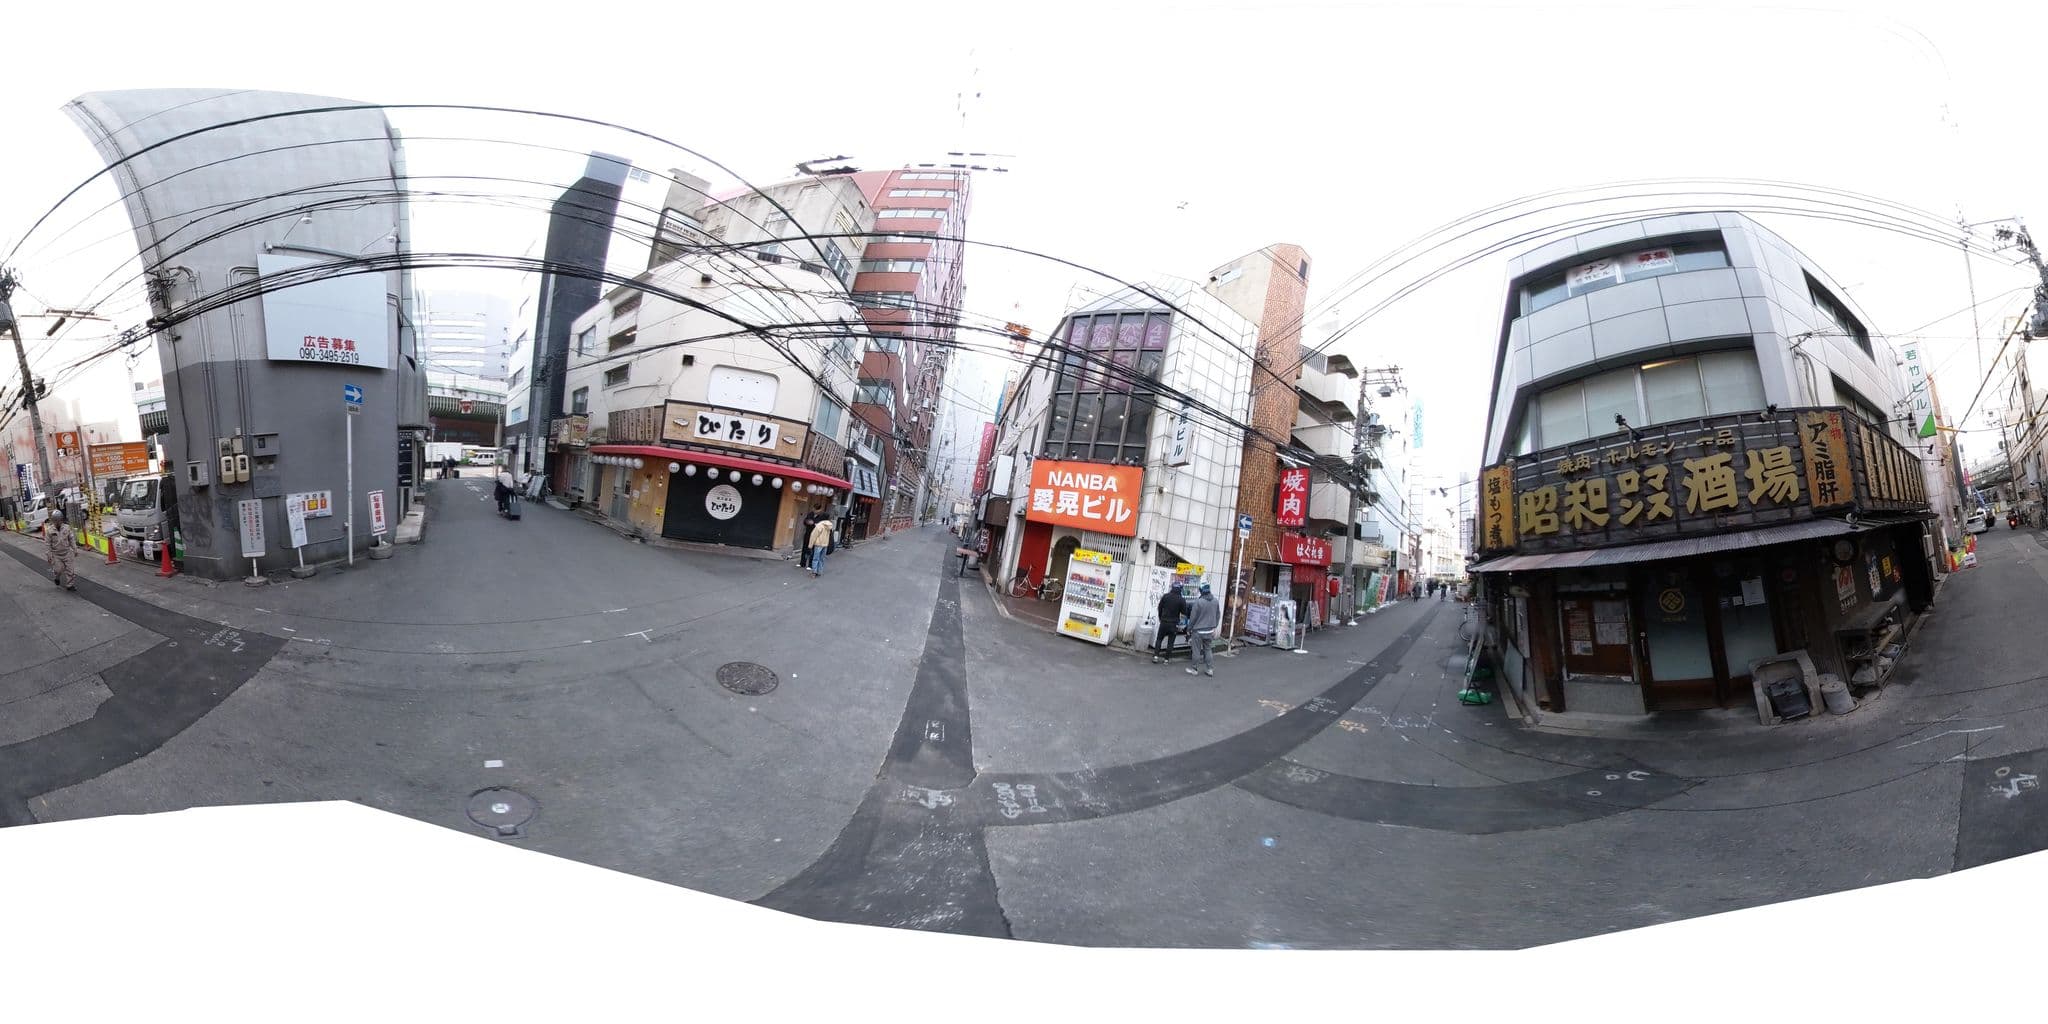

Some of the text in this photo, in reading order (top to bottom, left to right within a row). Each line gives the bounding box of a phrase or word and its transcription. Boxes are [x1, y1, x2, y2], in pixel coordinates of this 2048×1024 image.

[299, 347, 360, 363] 090-3495-2519
[303, 335, 356, 352] 広告募集
[1904, 349, 1928, 410] 若竹ビル
[698, 414, 771, 444] ぴたり
[1829, 412, 1842, 440] 名物
[1807, 421, 1839, 504] アミ脂肝
[1048, 470, 1118, 492] NANBA
[1282, 470, 1306, 516] 焼肉
[1519, 445, 1800, 536] 昭和ロマンス酒場
[1032, 488, 1132, 523] 愛晃ビル
